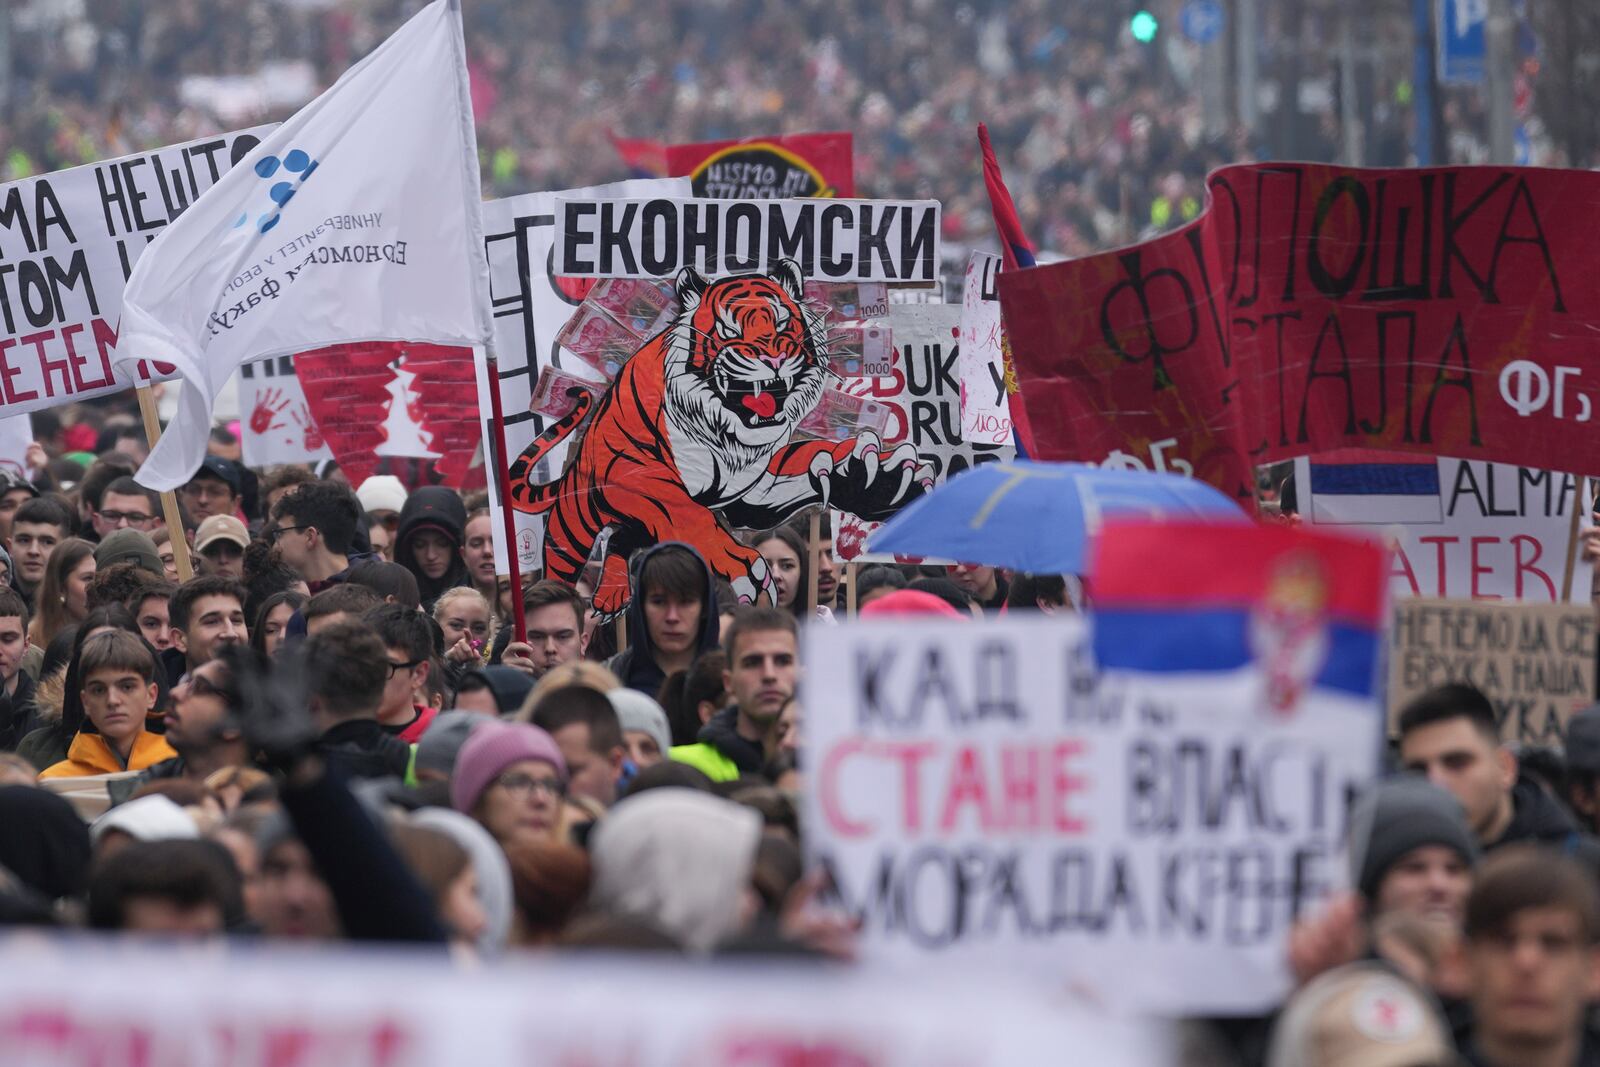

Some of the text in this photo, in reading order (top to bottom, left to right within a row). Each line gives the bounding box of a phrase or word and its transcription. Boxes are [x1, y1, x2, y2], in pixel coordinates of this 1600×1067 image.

[563, 200, 936, 279] ЕКОНОМСКИ
[861, 304, 886, 317] 1000
[0, 314, 177, 406] ЕЋЕМ
[864, 362, 890, 375] 1000
[1389, 534, 1557, 603] ATER
[852, 638, 1029, 730] КАД
[819, 738, 1091, 838] СТАНЕ
